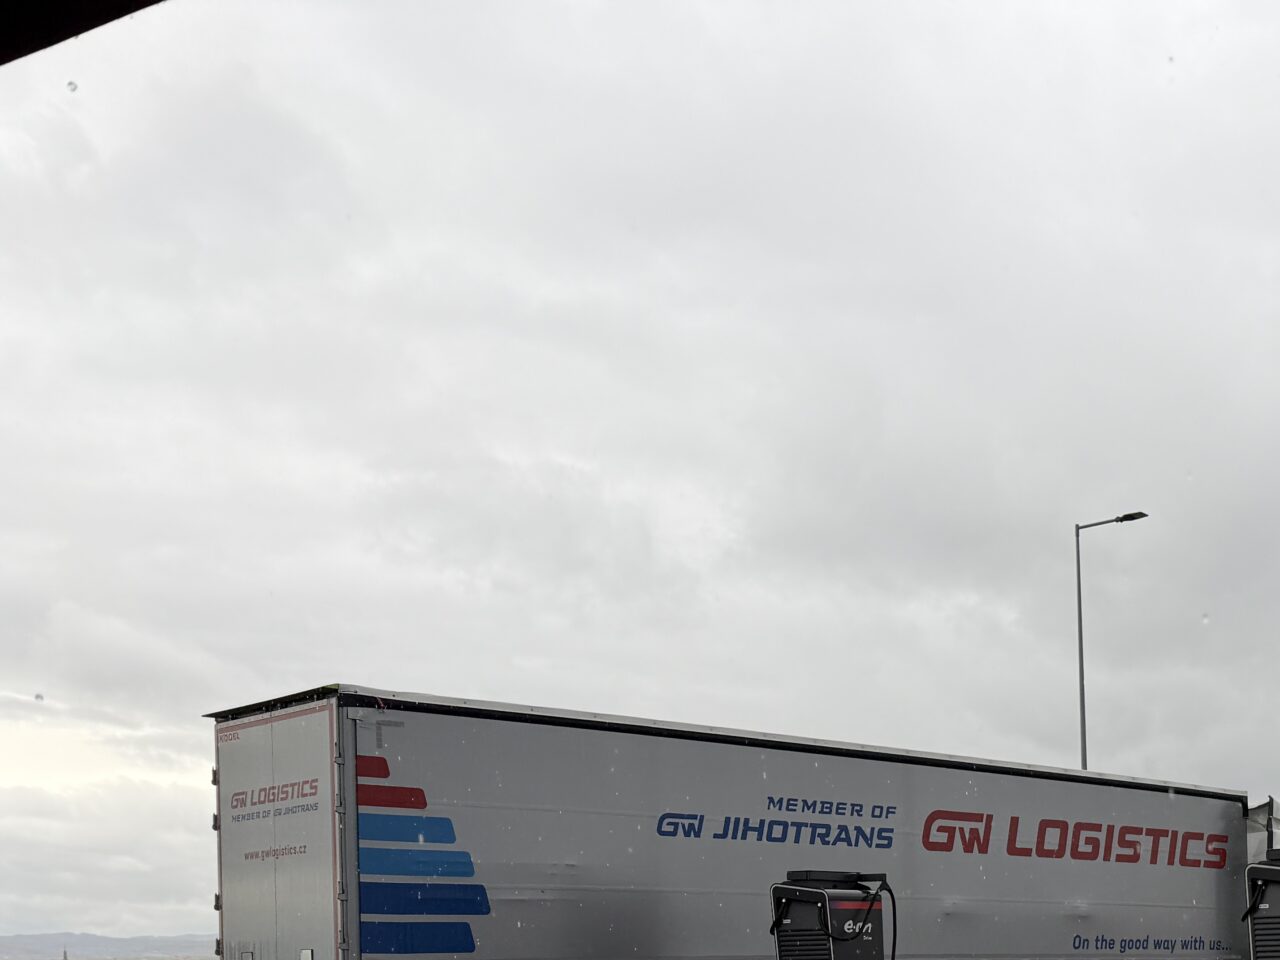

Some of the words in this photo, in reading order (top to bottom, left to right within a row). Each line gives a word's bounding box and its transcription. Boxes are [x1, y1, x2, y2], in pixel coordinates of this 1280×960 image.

[251, 778, 319, 806] LOGISTICS
[231, 811, 260, 823] MEMBER
[262, 809, 271, 819] OF
[283, 802, 319, 816] JIHOTRANS
[767, 796, 863, 817] MEMBER
[871, 805, 896, 819] OF
[656, 813, 704, 838] GW
[713, 816, 894, 849] JIHOTRANS
[922, 809, 994, 854] GW
[1006, 816, 1228, 869] LOGISTICS
[244, 844, 307, 861] www.gwlogistics.cz
[1073, 935, 1090, 950] On
[1095, 935, 1115, 950] the
[1120, 935, 1149, 953] good
[1154, 940, 1176, 953] way
[1181, 935, 1205, 950] with
